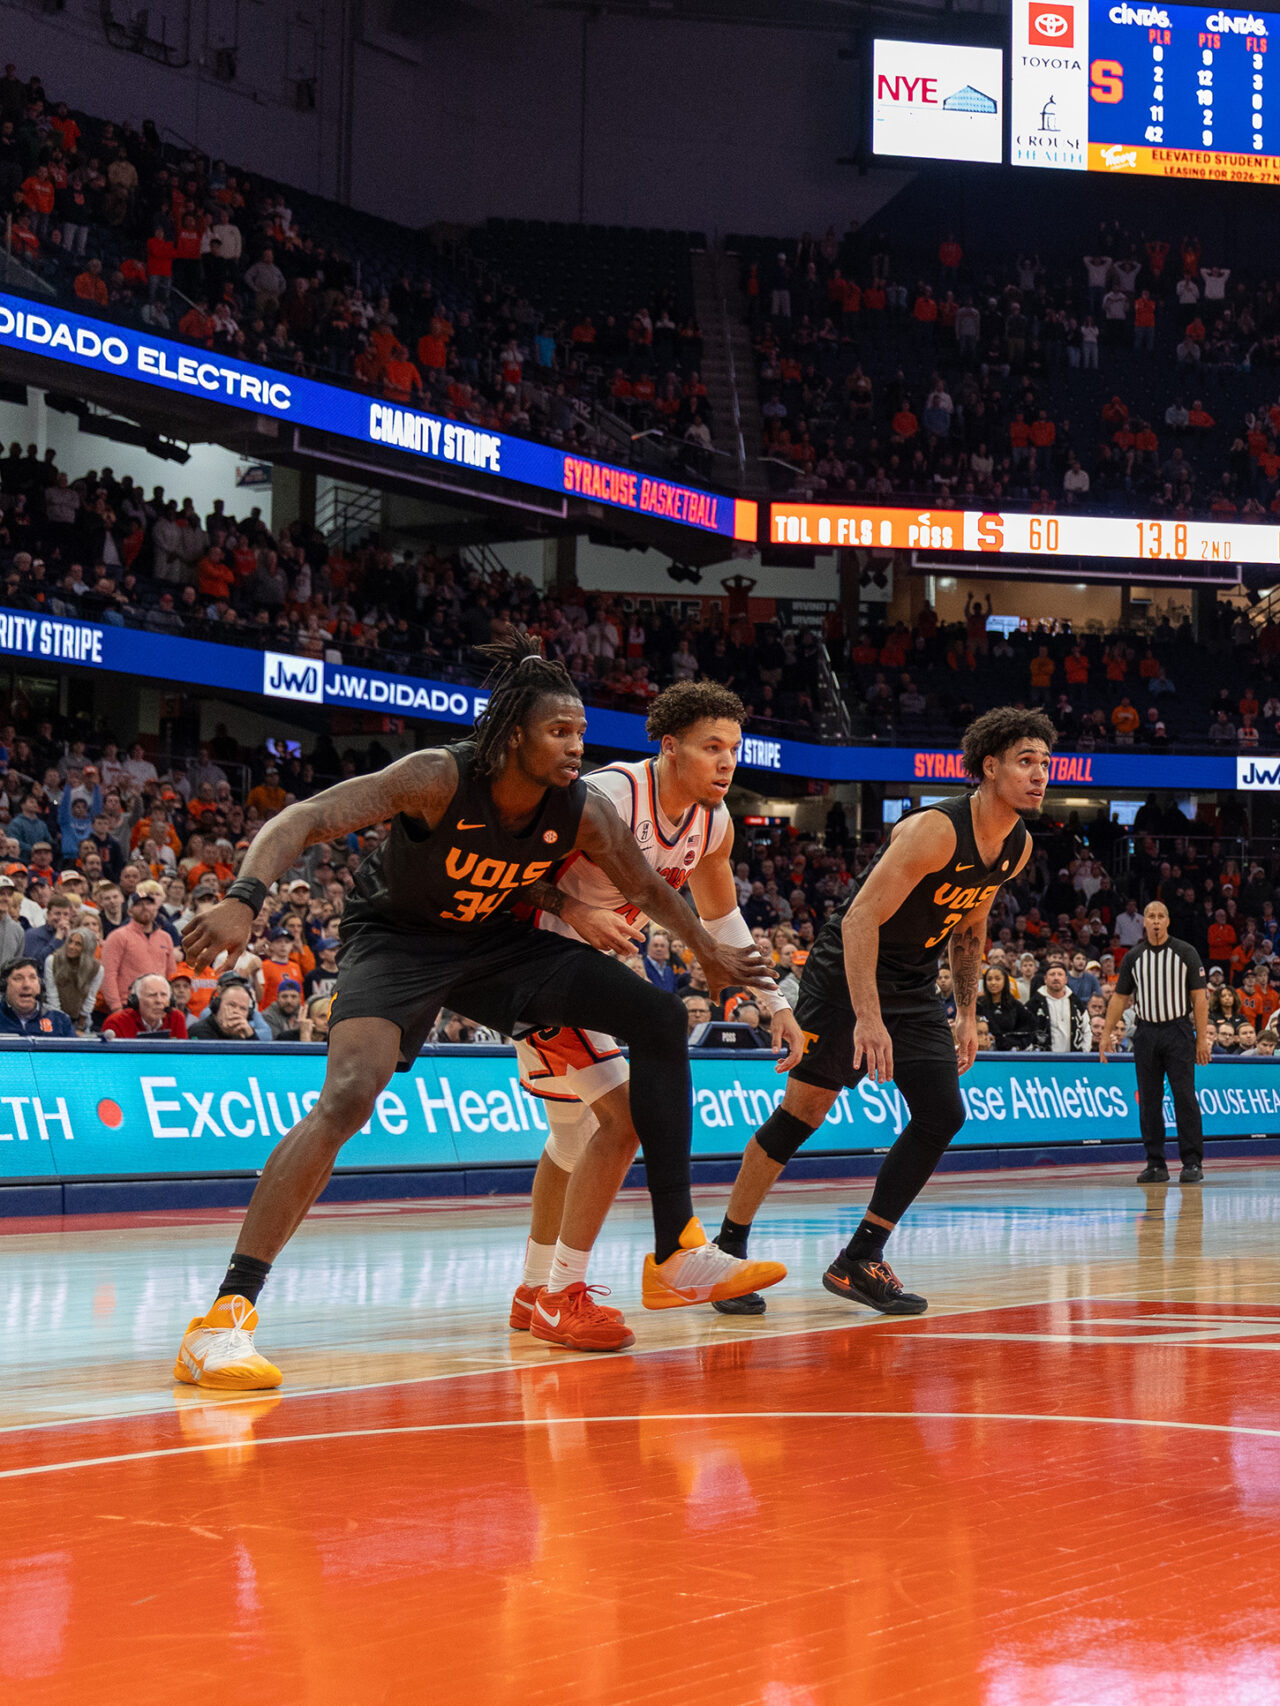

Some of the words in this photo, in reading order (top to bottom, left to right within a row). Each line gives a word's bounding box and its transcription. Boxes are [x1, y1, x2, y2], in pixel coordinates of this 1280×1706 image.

[1149, 28, 1171, 45] PLR
[1198, 32, 1221, 49] PTS
[1246, 36, 1267, 53] FLS
[1021, 56, 1081, 71] TOYOTA
[1252, 53, 1263, 70] 3
[878, 74, 938, 103] NYE
[1090, 58, 1123, 104] S
[1153, 66, 1164, 83] 2
[1197, 70, 1213, 86] 12
[1252, 73, 1263, 91] 3
[1153, 85, 1164, 101] 4
[1149, 105, 1164, 122] 11
[1202, 109, 1213, 126] 2
[1017, 136, 1080, 150] CROUSE
[1144, 125, 1164, 143] 42
[1252, 133, 1263, 150] 3
[1152, 149, 1212, 165] ELEVATED
[1214, 154, 1270, 169] STUDENT
[1164, 167, 1206, 179] LEASING
[1208, 169, 1228, 180] FOR
[138, 346, 292, 410] ELECTRIC
[369, 403, 442, 456] CHARITY
[444, 423, 501, 472] STRIPE
[564, 456, 637, 506] SYRACUSE
[639, 478, 718, 529] BASKETBALL
[775, 516, 812, 543] TOL
[837, 518, 873, 546] FLS
[908, 524, 953, 549] POSS
[977, 513, 1004, 552] S
[1029, 518, 1059, 551] 60
[1136, 522, 1188, 560] 13.8
[1201, 540, 1232, 560] 2ND
[40, 621, 103, 663] STRIPE
[744, 740, 781, 768] STRIPE
[914, 753, 970, 778] SYRAC
[1050, 757, 1092, 782] TBALL
[445, 846, 553, 889] VOLS
[440, 889, 513, 922] 34
[933, 882, 999, 910] VOLS
[924, 912, 963, 949] 3
[139, 1076, 408, 1139] Excluse
[415, 1077, 548, 1133] Healt
[692, 1080, 784, 1128] artne
[863, 1077, 1007, 1134] Syuse
[1010, 1076, 1129, 1119] Athletics
[1197, 1088, 1250, 1115] OUSE
